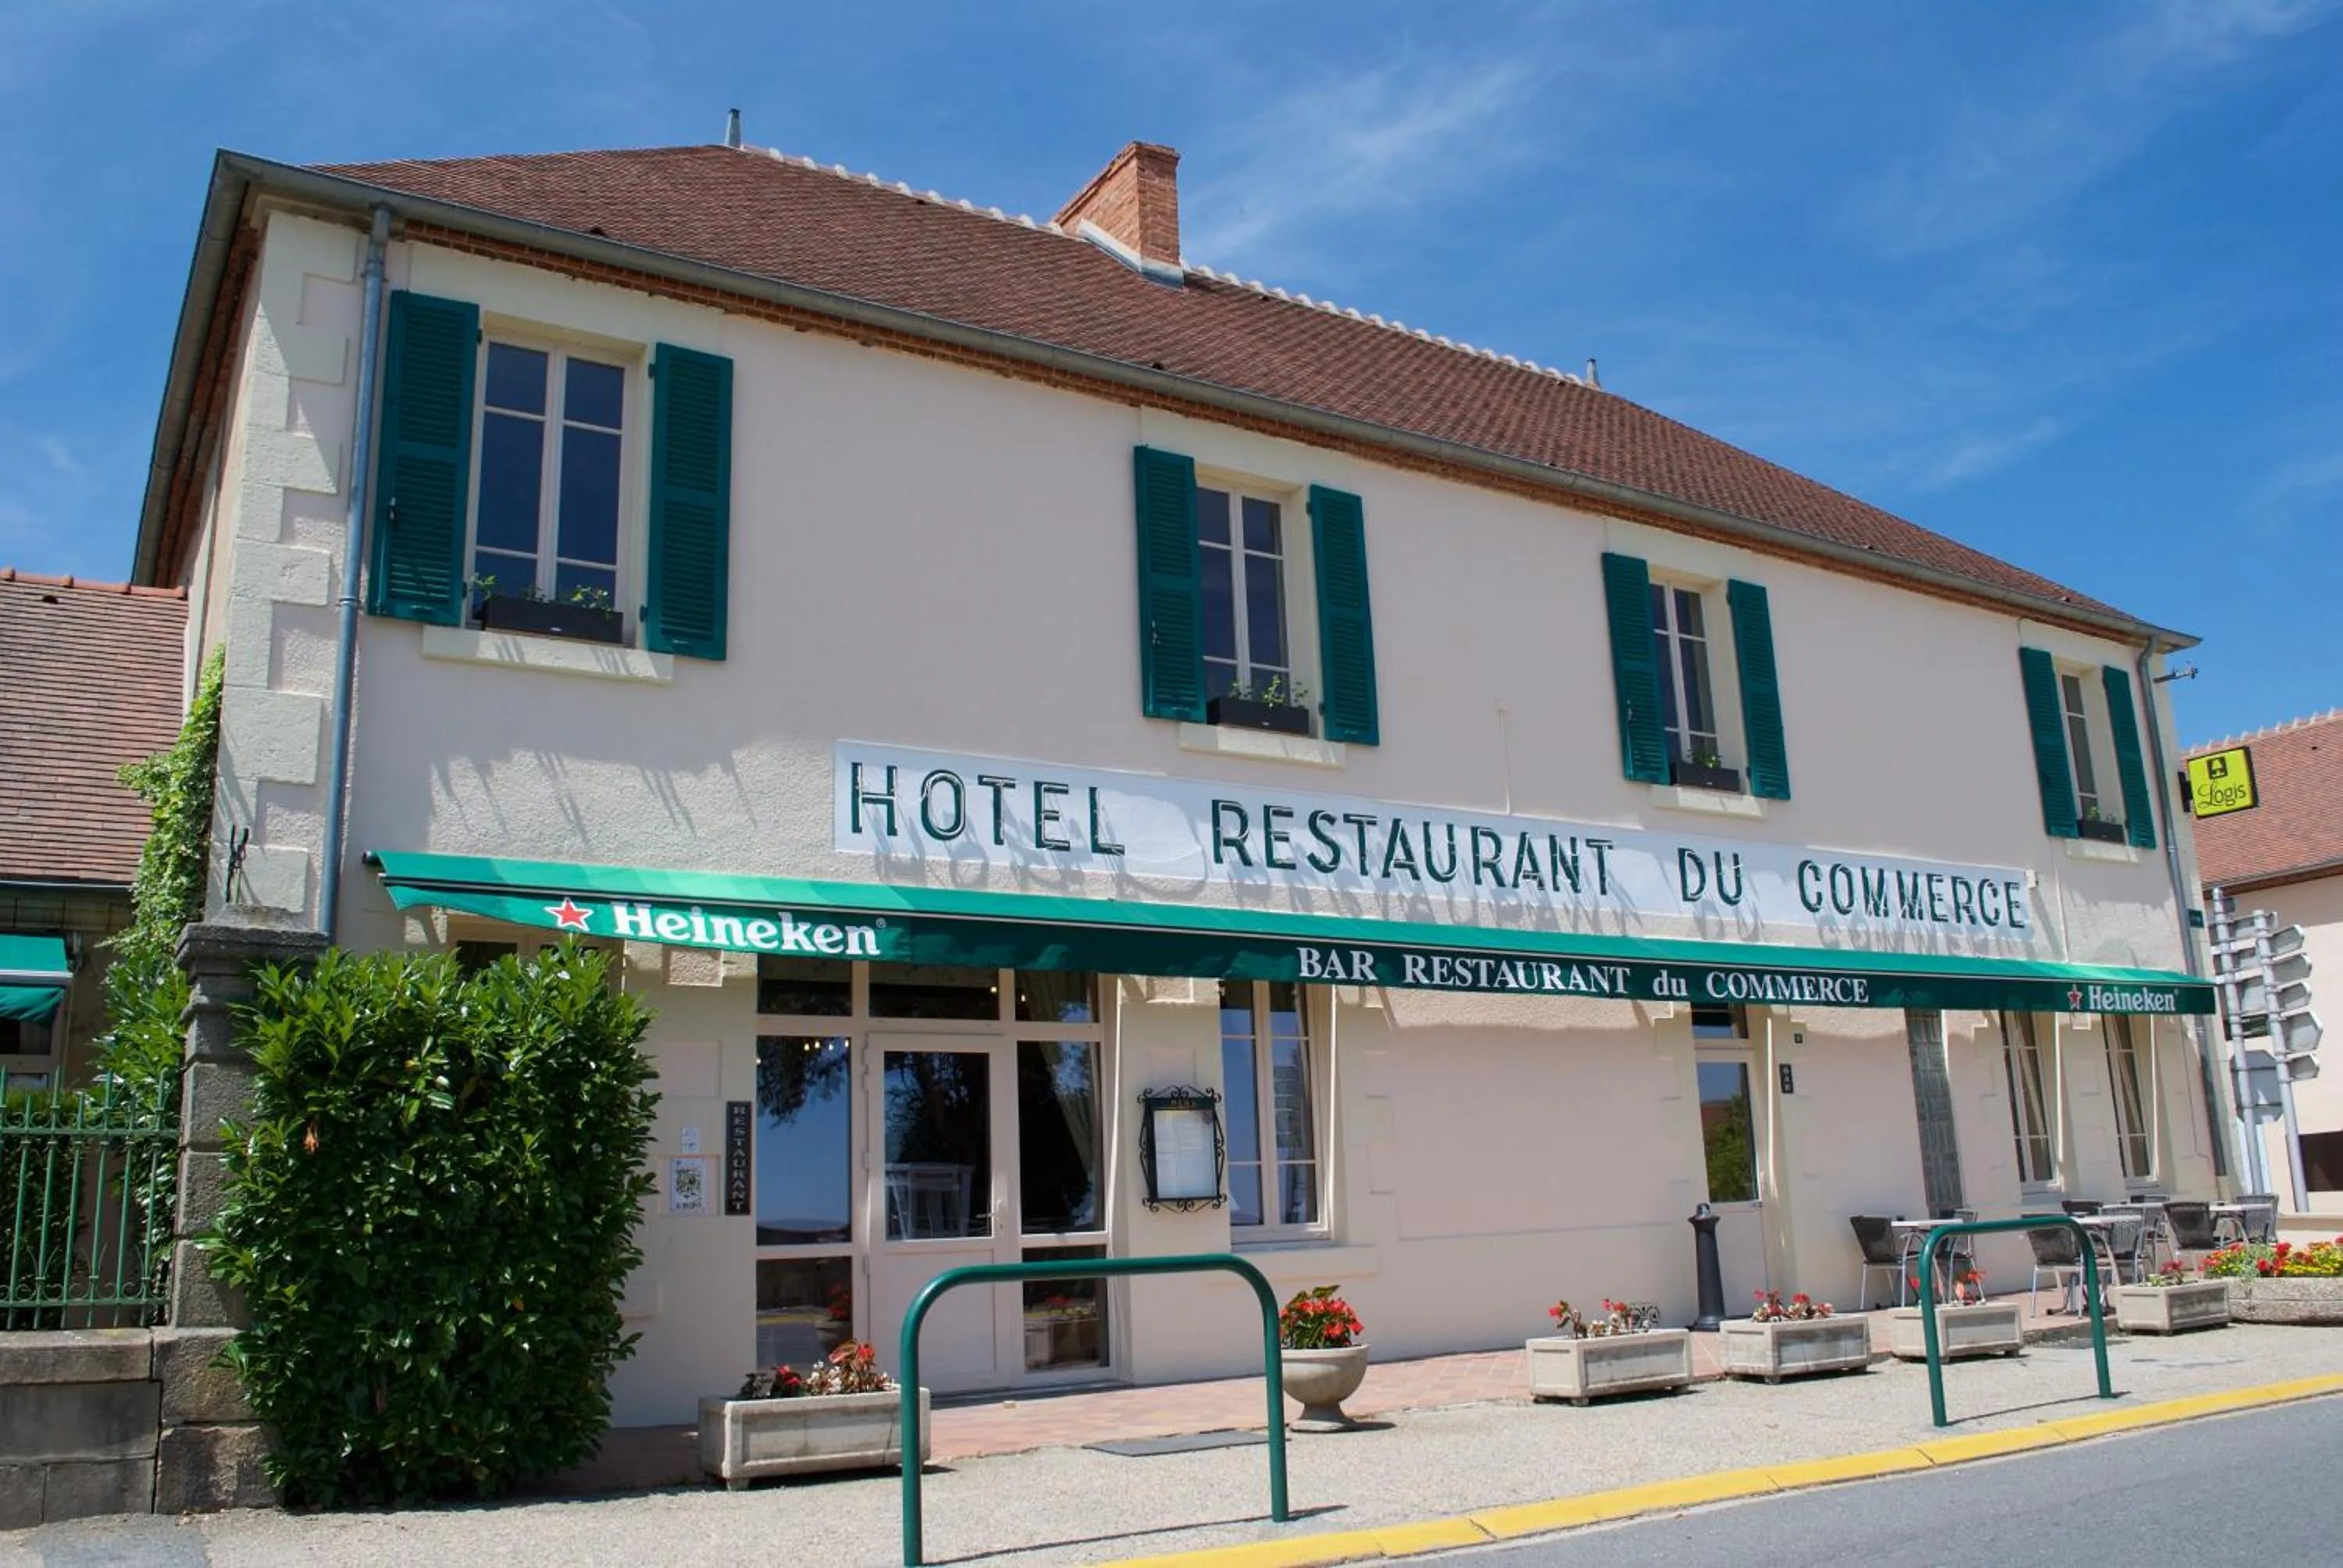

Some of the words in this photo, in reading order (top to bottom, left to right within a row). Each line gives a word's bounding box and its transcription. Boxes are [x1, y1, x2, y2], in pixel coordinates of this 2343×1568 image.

[2198, 782, 2247, 808] Logis
[851, 761, 1125, 856] HOTEL
[1212, 798, 1614, 896] RESTAURANT
[1677, 847, 1743, 905] DU
[1798, 860, 2026, 929] COMMERCE
[612, 900, 880, 956] Heineken
[1297, 946, 1378, 981] BAR
[1403, 953, 1631, 994] RESTAURANT
[1653, 968, 1688, 998] du
[1706, 971, 1869, 1004] COMMERCE
[2088, 984, 2176, 1013] Heineken
